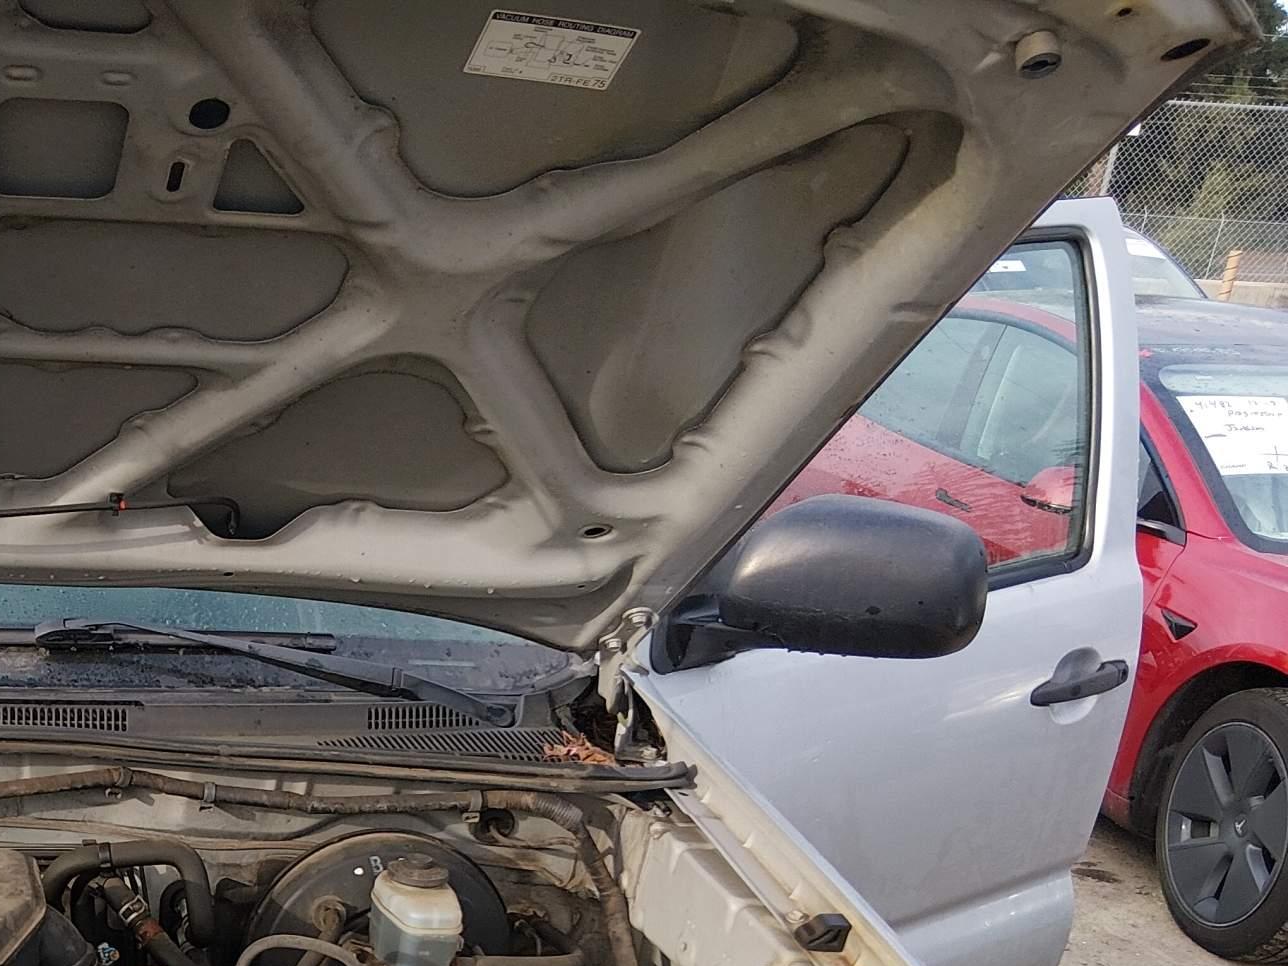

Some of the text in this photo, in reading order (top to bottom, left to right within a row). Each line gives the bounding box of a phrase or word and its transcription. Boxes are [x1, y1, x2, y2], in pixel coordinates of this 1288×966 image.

[495, 13, 530, 23] VACUUM
[532, 17, 555, 26] HOSE
[558, 21, 594, 32] ROUTING
[597, 27, 635, 37] DIAGRAM
